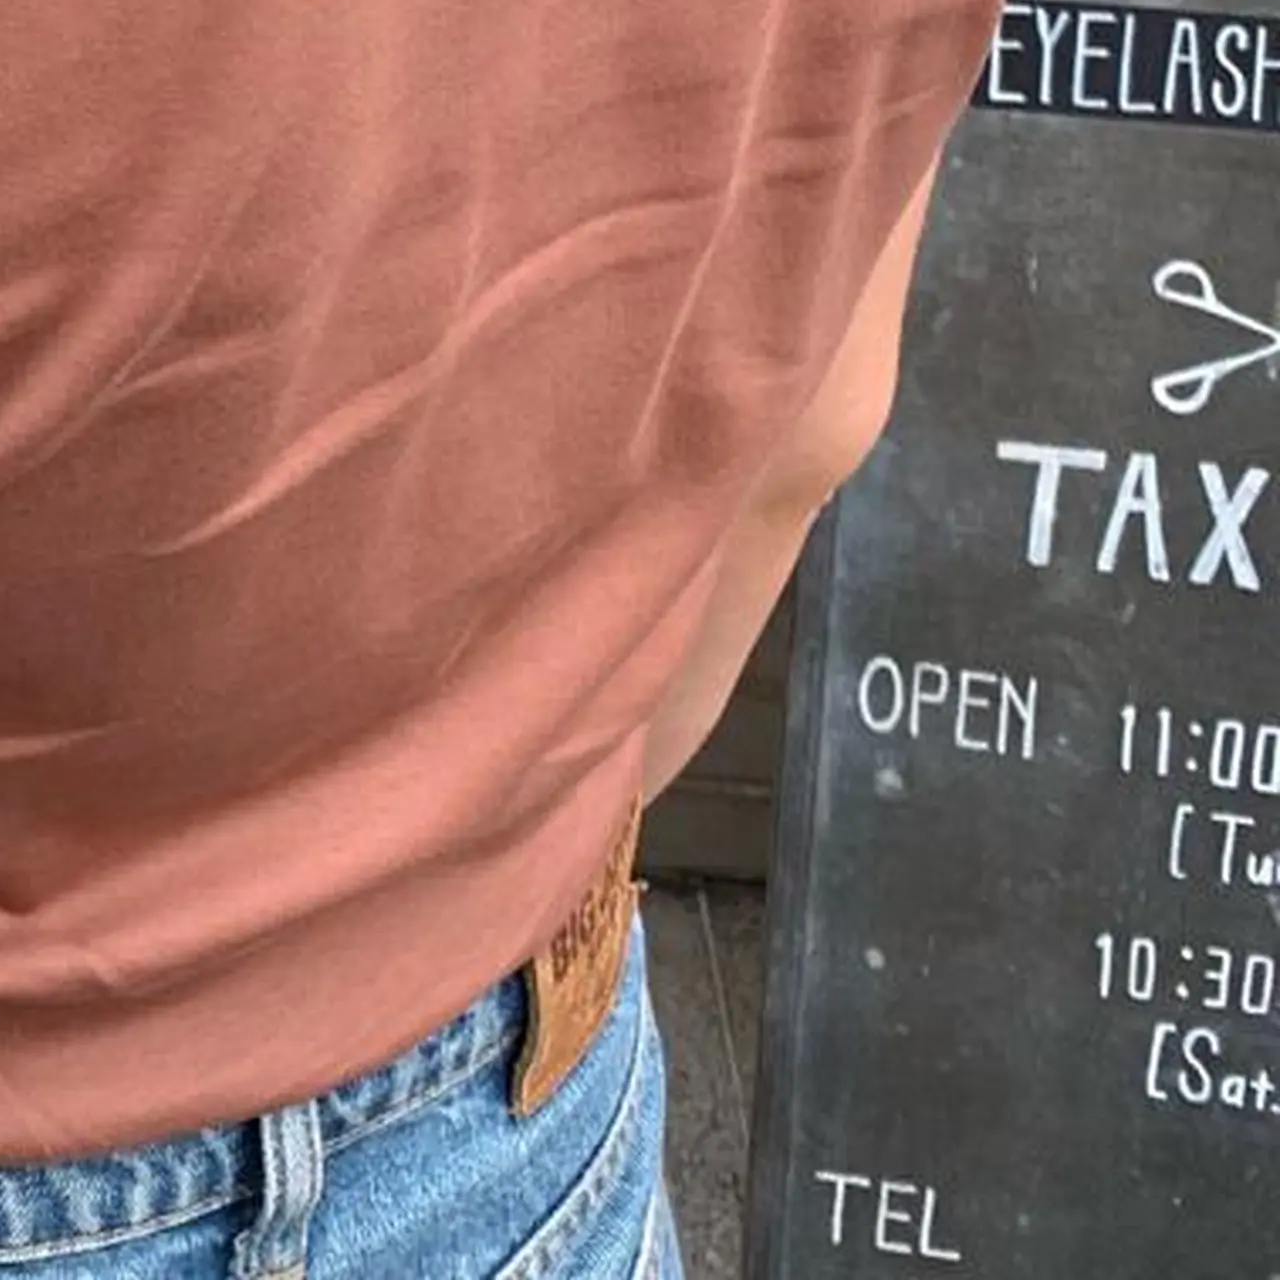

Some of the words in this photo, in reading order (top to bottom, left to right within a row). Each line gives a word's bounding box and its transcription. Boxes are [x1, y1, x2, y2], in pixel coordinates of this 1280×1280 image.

[988, 4, 1280, 123] EYELASH
[996, 441, 1270, 591] TAX
[858, 655, 1038, 759] OPEN
[1121, 703, 1280, 794] 11:00
[1170, 803, 1280, 887] [Tu
[1096, 933, 1275, 1016] 10:30
[815, 1170, 962, 1262] TEL
